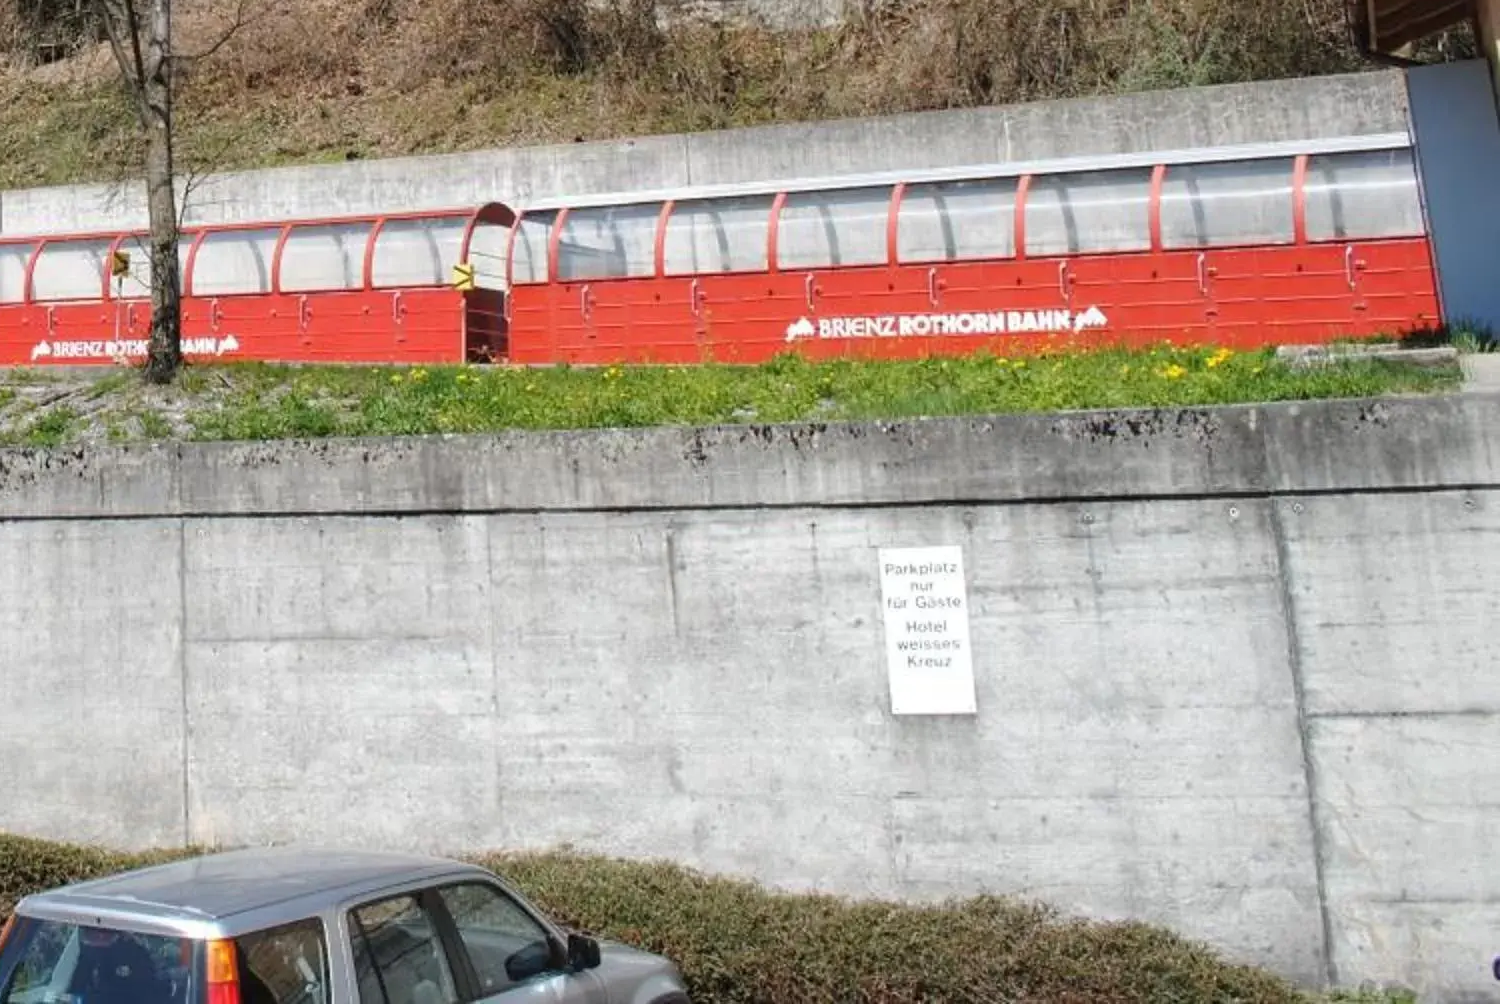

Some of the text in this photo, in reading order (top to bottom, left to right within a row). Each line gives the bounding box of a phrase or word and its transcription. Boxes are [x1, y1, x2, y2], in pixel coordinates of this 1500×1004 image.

[818, 309, 1071, 338] BRIENZ ROTHORN BAHN
[52, 340, 103, 357] BRIENZ
[884, 562, 957, 576] Parkplatz
[910, 581, 933, 593] nur
[887, 595, 961, 609] für Gäste
[905, 620, 947, 634] Hotel
[897, 639, 961, 651] weisses
[907, 656, 952, 668] Kreuz
